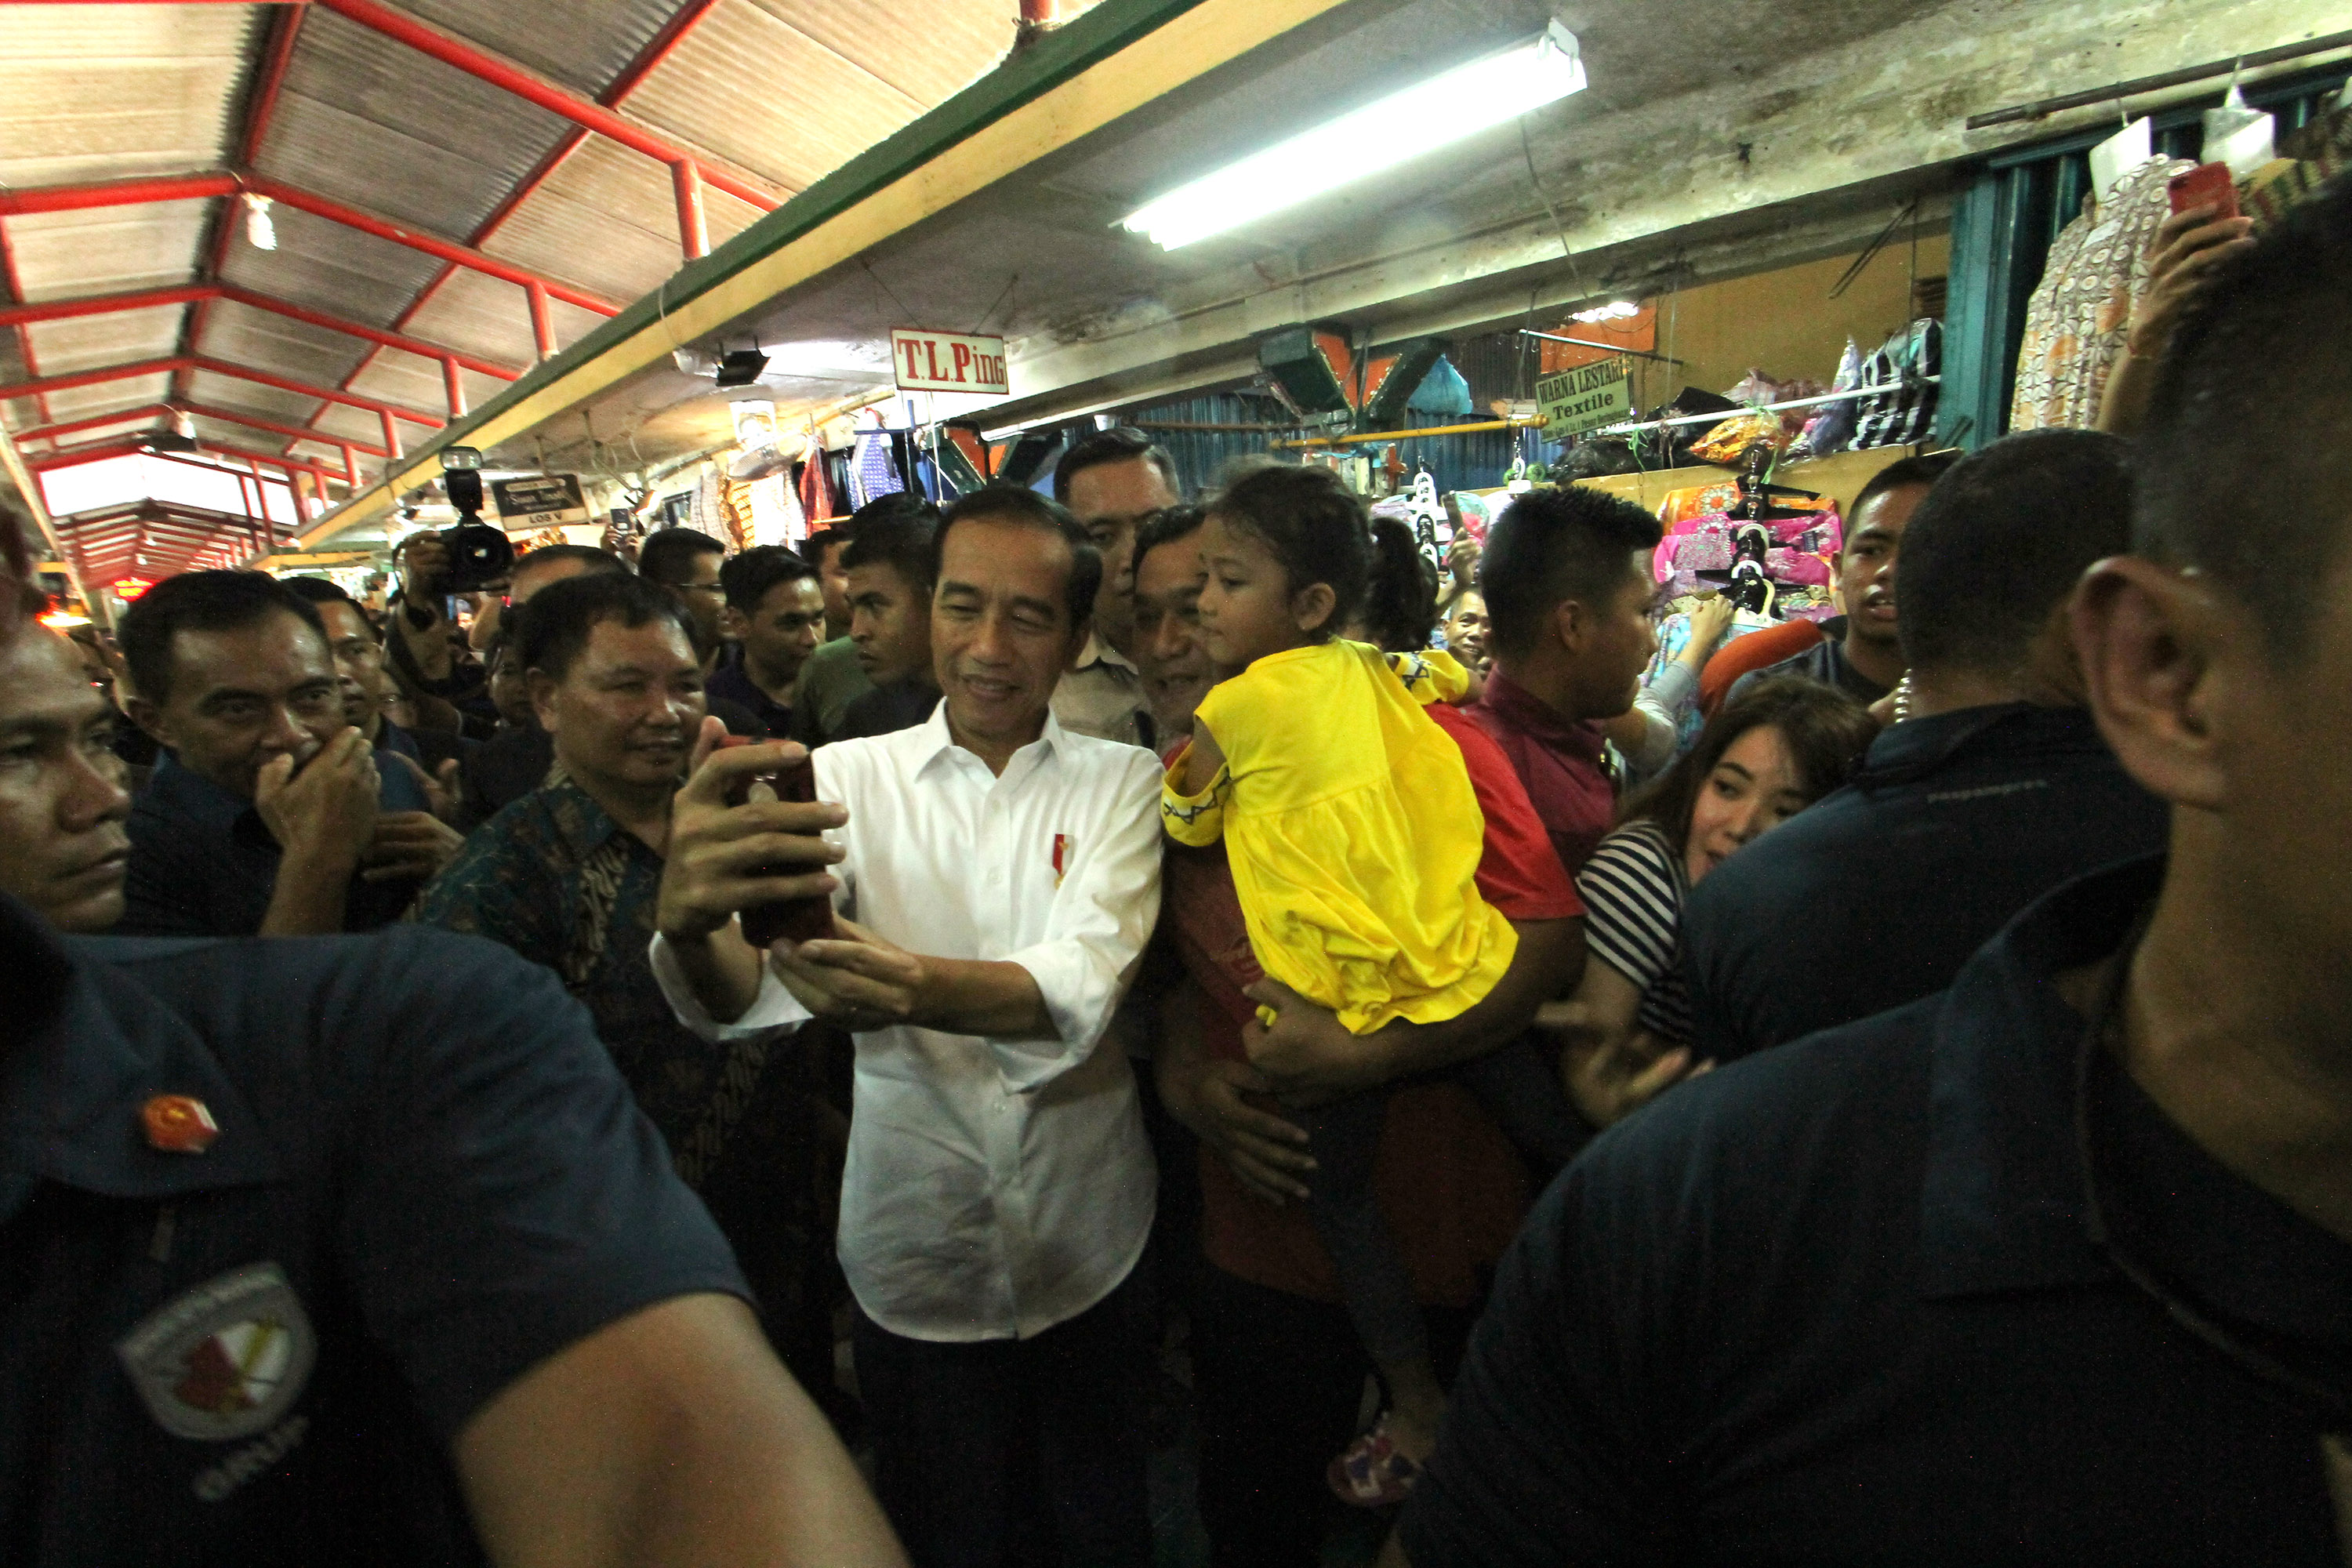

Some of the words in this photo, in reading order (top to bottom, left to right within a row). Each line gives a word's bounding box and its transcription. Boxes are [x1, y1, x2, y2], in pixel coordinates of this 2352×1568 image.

[1538, 374, 1577, 405] WARNA
[1577, 358, 1624, 393] LESTARI
[1553, 392, 1614, 420] Textile
[529, 514, 551, 524] LOS
[554, 511, 562, 521] V
